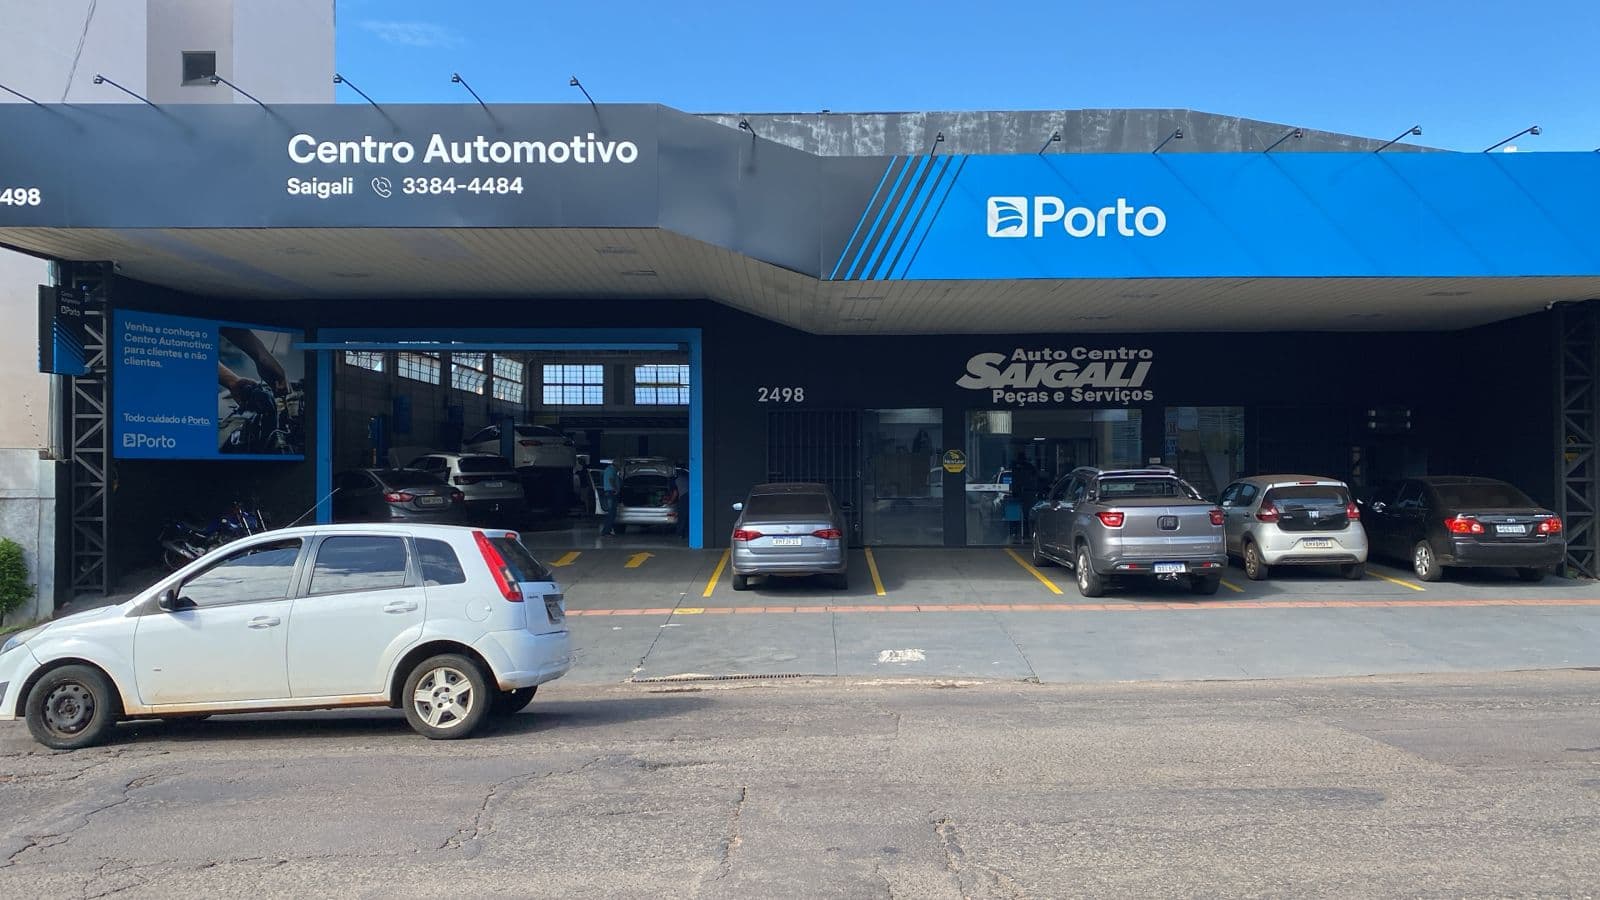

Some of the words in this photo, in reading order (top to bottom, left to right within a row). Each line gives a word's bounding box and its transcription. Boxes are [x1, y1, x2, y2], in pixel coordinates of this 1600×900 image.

[287, 133, 415, 164] Centro
[423, 132, 639, 164] Automotivo
[286, 176, 354, 199] Saigali
[402, 176, 524, 195] 3384-4484
[1034, 196, 1166, 238] Porto
[124, 321, 153, 332] Venha
[162, 328, 200, 339] conheça
[124, 333, 157, 344] Centro
[124, 346, 145, 355] para
[147, 347, 182, 358] clientes
[191, 352, 207, 360] não
[1010, 348, 1068, 361] Auto
[1071, 347, 1153, 360] Centro
[124, 356, 163, 368] clientes.
[955, 352, 1152, 390] SAIGALI
[758, 387, 804, 403] 2498
[992, 389, 1049, 406] Peças
[1053, 391, 1065, 403] e
[1070, 387, 1154, 405] Serviços
[123, 413, 145, 422] Todo
[146, 414, 180, 424] cuidado
[137, 433, 176, 448] Porto
